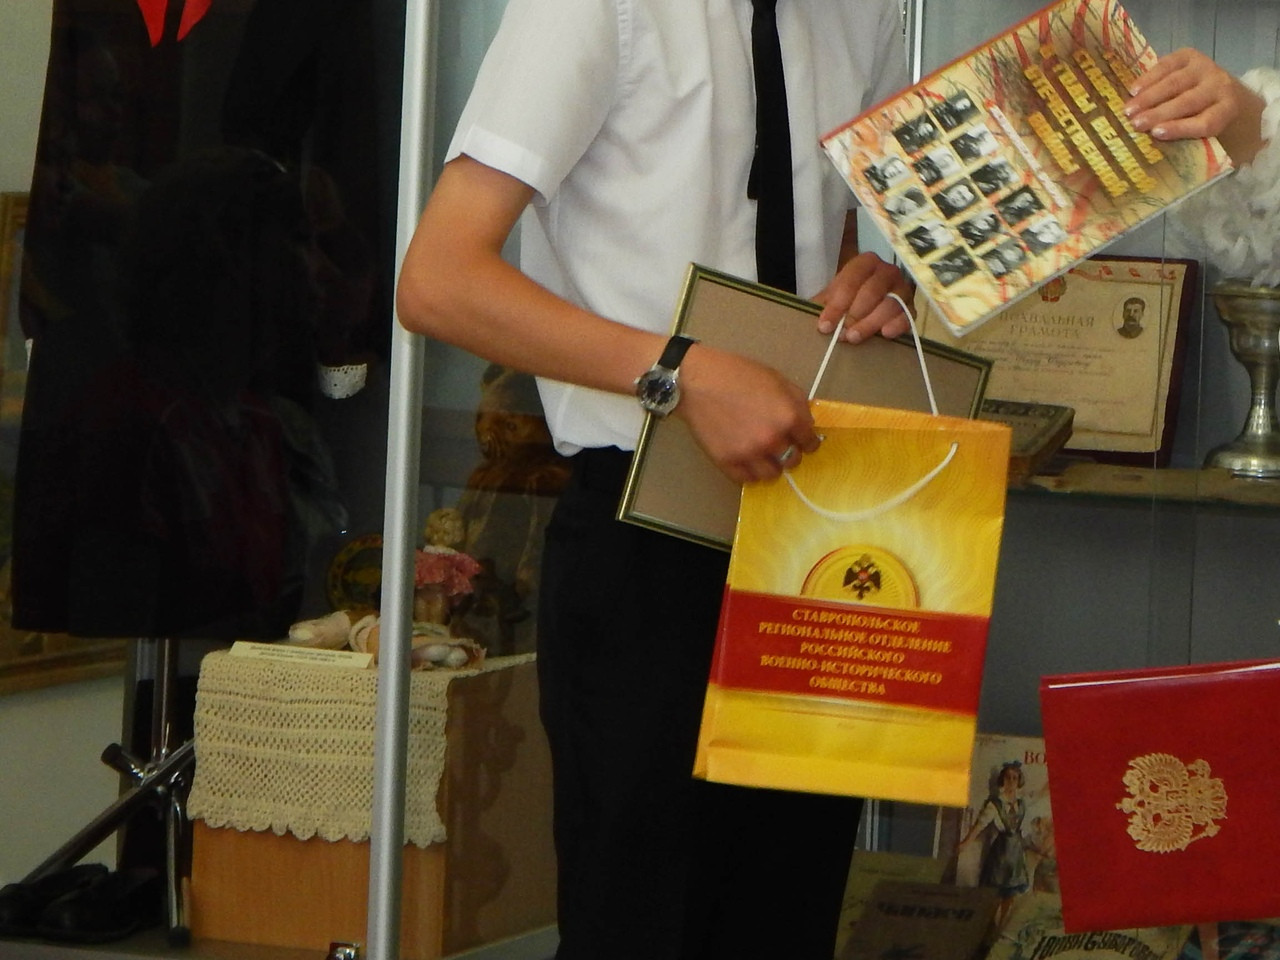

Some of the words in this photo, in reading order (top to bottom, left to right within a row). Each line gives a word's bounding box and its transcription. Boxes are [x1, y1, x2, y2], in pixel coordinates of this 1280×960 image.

[1024, 63, 1130, 198] ОТЕЧЕСТВЕННОЙ
[792, 608, 921, 634] СТАВРОПОЛЬСКОЕ
[758, 622, 868, 645] РЕГИОНАЛЬНОЕ
[868, 632, 953, 654] ОТДЕЛЕНИЕ
[800, 641, 906, 665] РОССИЙСКОГО
[760, 654, 944, 686] ВОЕННО-ИСТОРИЧЕСКОГО
[808, 675, 887, 696] ОБЩЕСТВА
